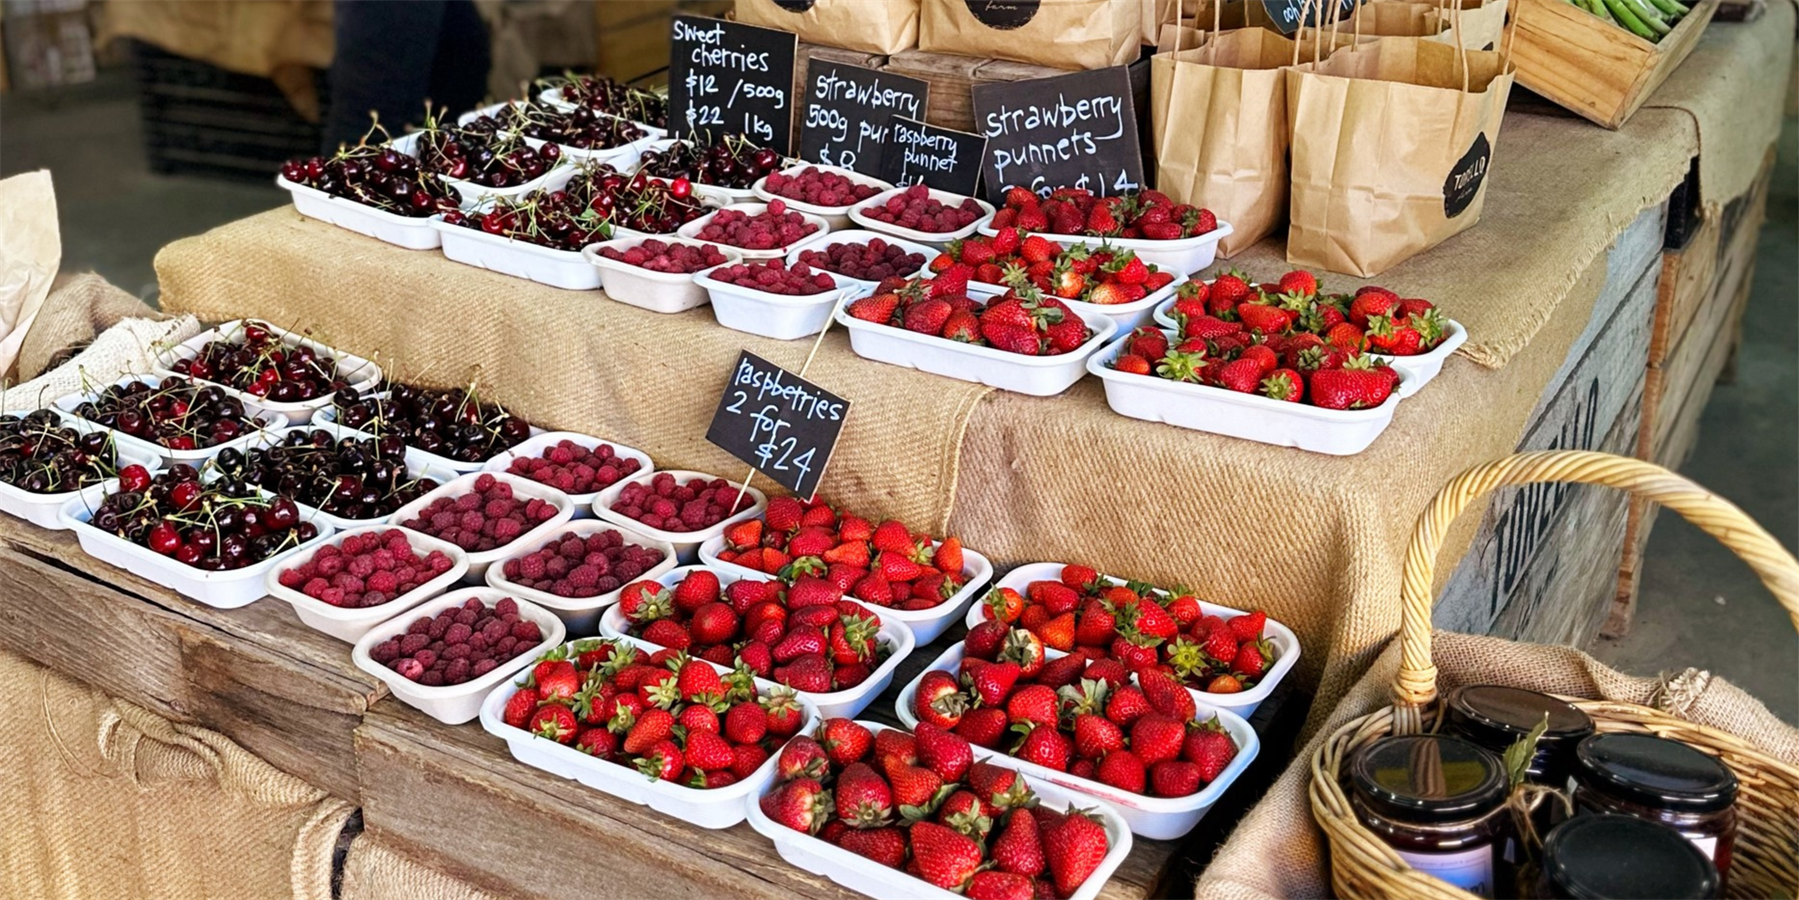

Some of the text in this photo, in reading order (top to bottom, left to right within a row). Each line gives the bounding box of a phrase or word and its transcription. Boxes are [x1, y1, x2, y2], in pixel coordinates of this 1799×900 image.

[691, 43, 769, 72] cherries
[685, 68, 719, 97] $12
[815, 69, 920, 120] strawberry
[685, 99, 725, 128] $22
[805, 104, 849, 142] 500g
[985, 93, 1124, 140] strawberry
[894, 122, 958, 158] raspberry
[902, 147, 958, 174] punnet
[993, 128, 1097, 184] punnets
[734, 357, 844, 421] raspberries
[725, 391, 791, 442] 2 for
[754, 436, 816, 492] $24
